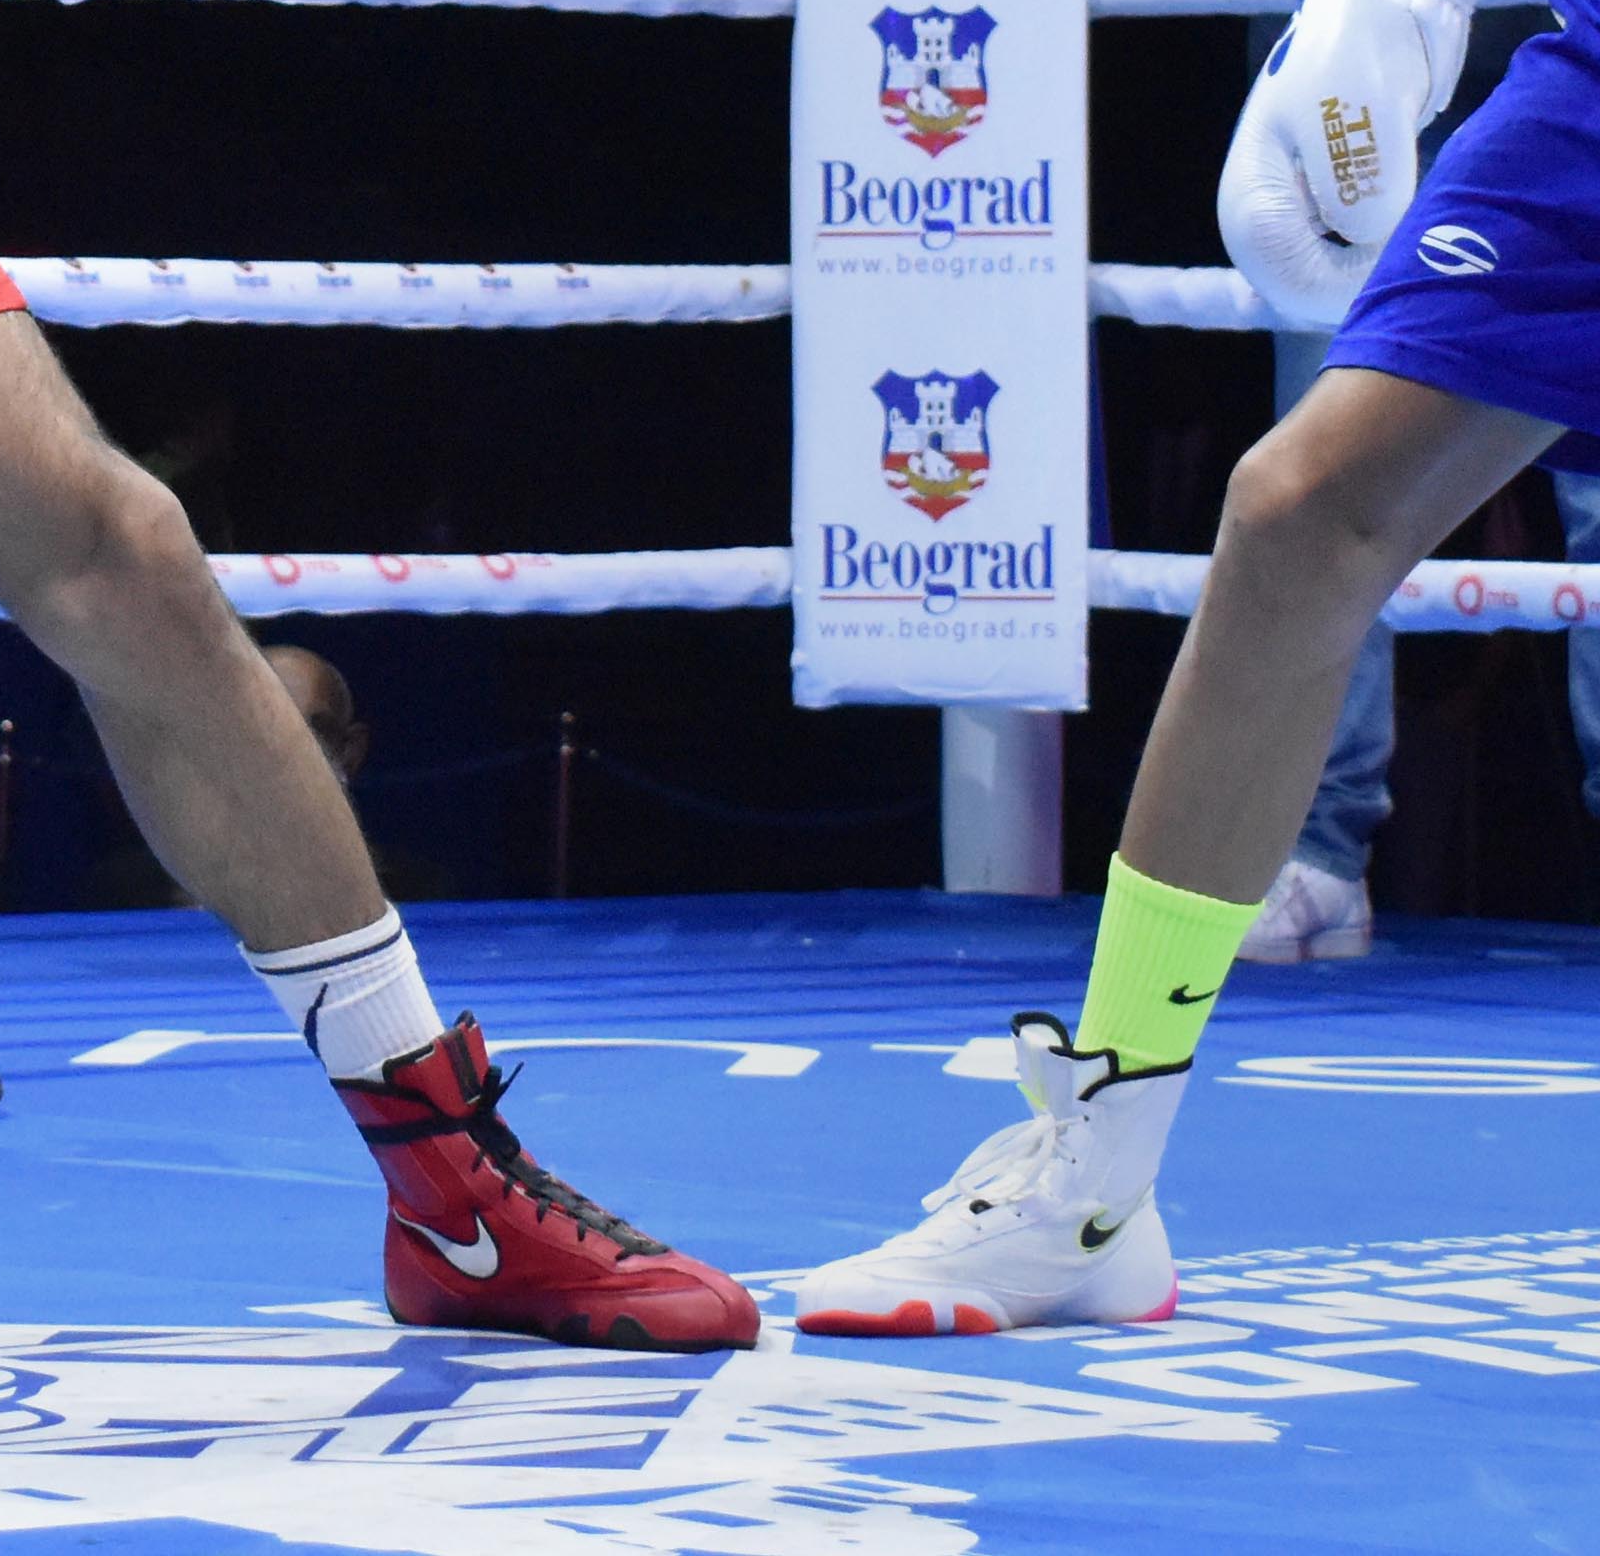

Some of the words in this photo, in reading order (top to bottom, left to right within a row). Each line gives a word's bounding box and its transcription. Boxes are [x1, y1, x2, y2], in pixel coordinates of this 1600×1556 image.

[1319, 96, 1359, 207] GREEN
[819, 159, 1052, 250] Beograd
[816, 253, 1055, 278] www.beograd.rs
[821, 524, 1055, 615] Beograd
[818, 617, 1057, 642] www.beograd.rs
